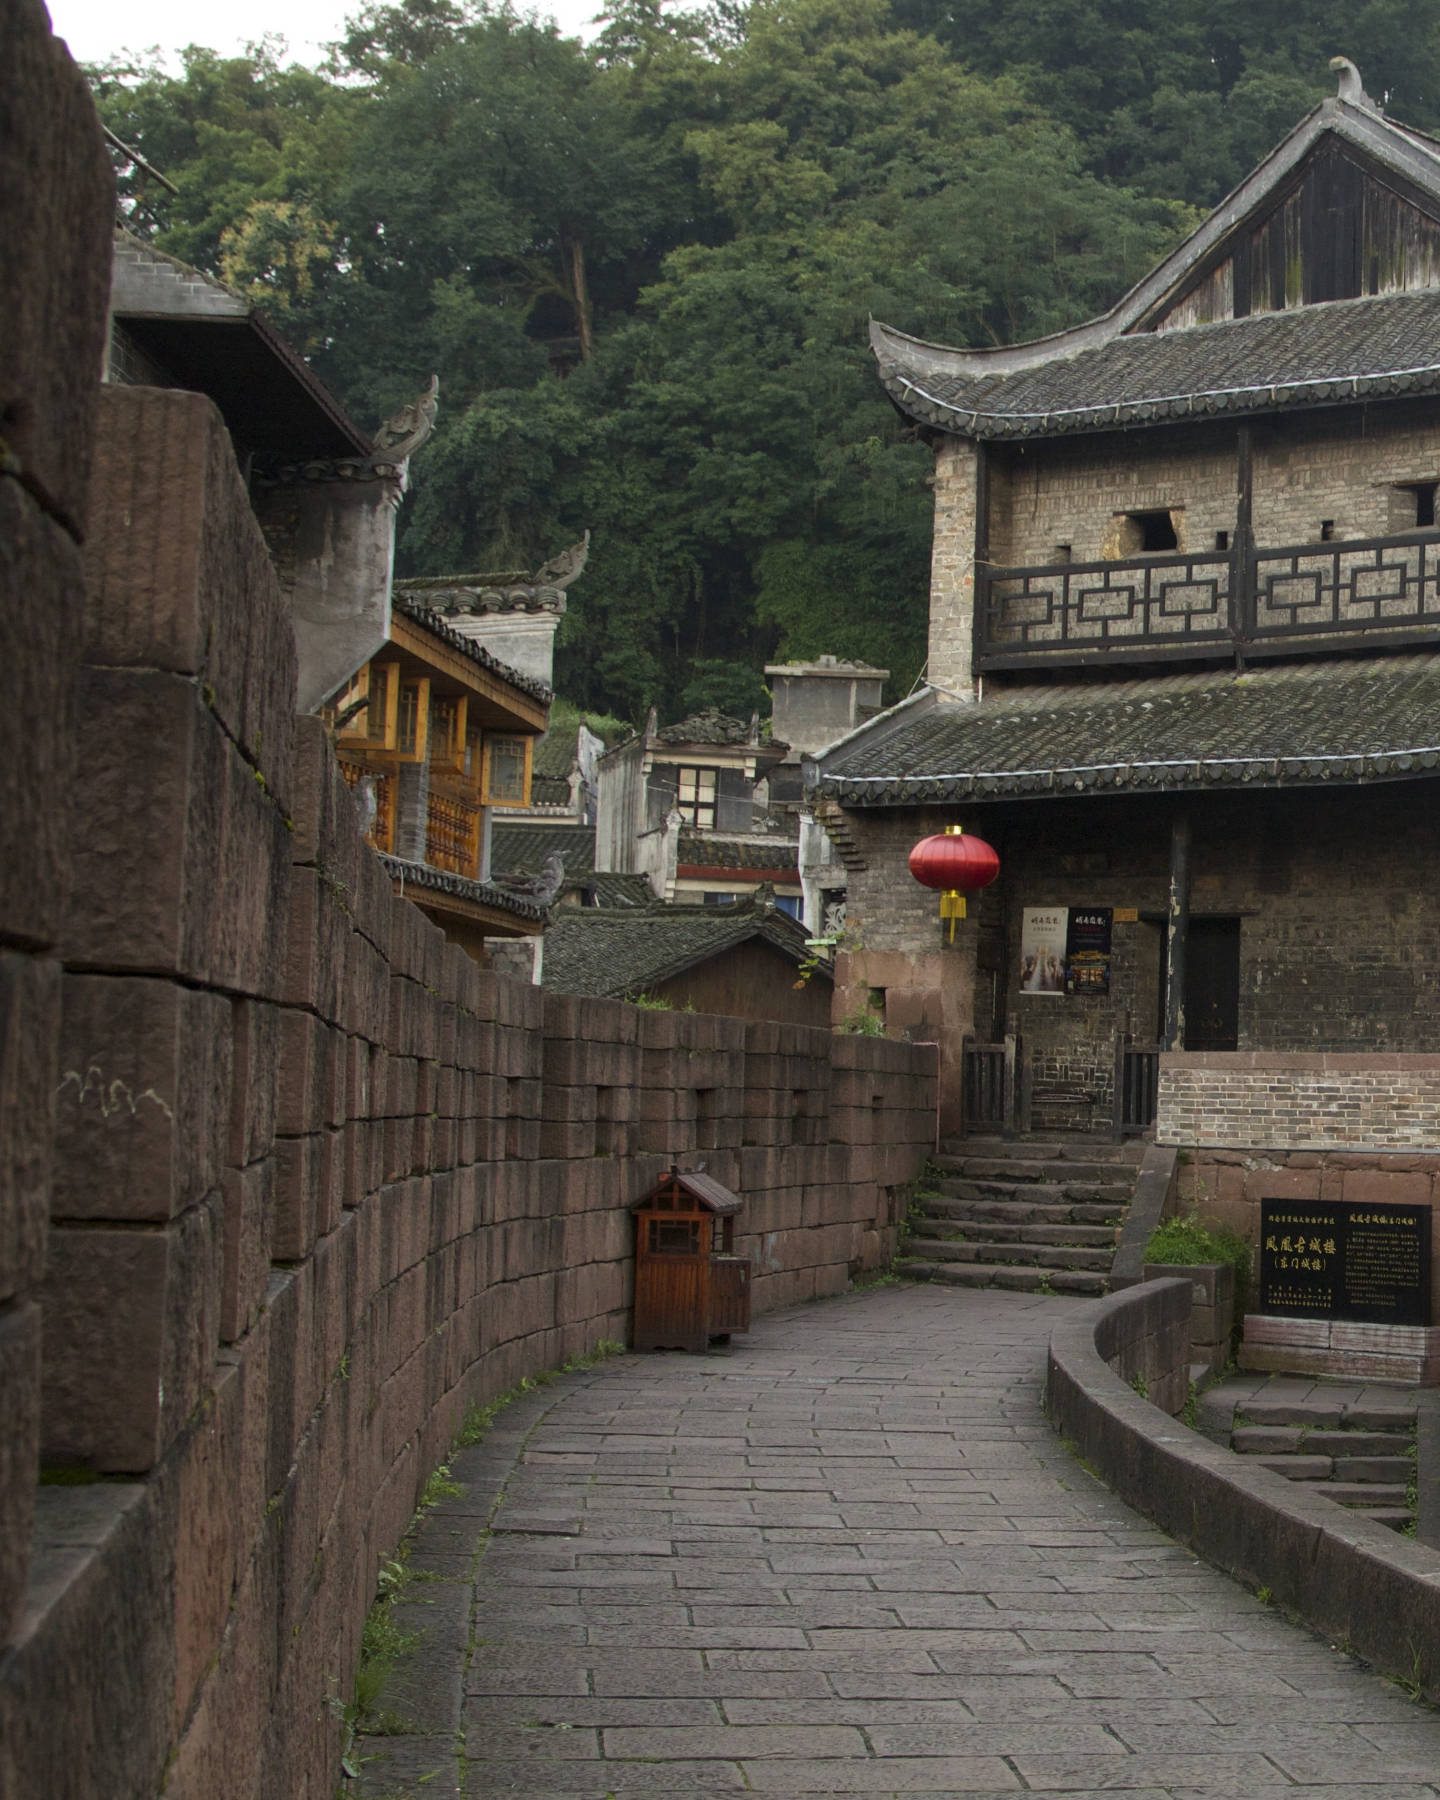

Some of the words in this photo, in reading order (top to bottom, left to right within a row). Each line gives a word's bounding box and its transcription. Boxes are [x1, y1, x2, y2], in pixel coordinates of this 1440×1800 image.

[1266, 1235, 1337, 1255] 凤凰古城楼
